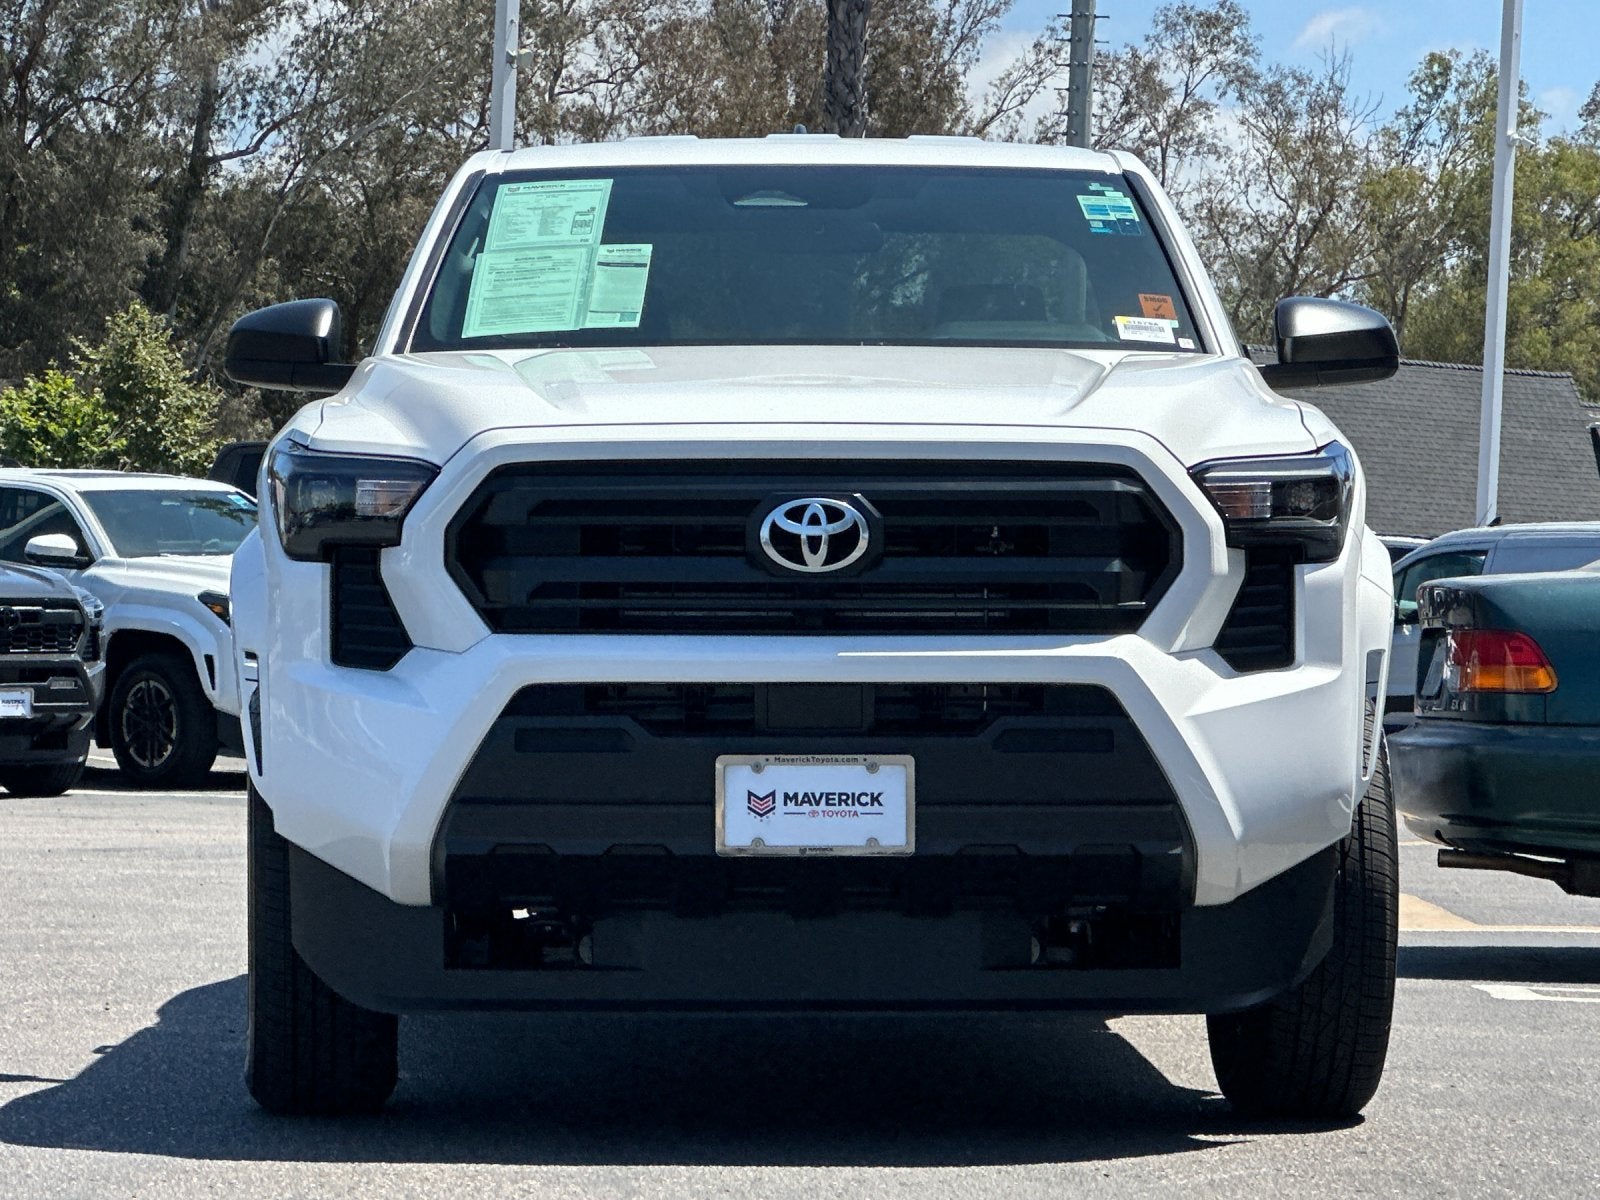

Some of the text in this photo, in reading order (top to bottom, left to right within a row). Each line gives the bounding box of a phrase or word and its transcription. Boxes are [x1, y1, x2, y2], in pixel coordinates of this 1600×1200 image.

[774, 756, 859, 764] MaverickToyota.com
[783, 792, 884, 807] MAVERICK
[821, 810, 860, 818] TOYOTA
